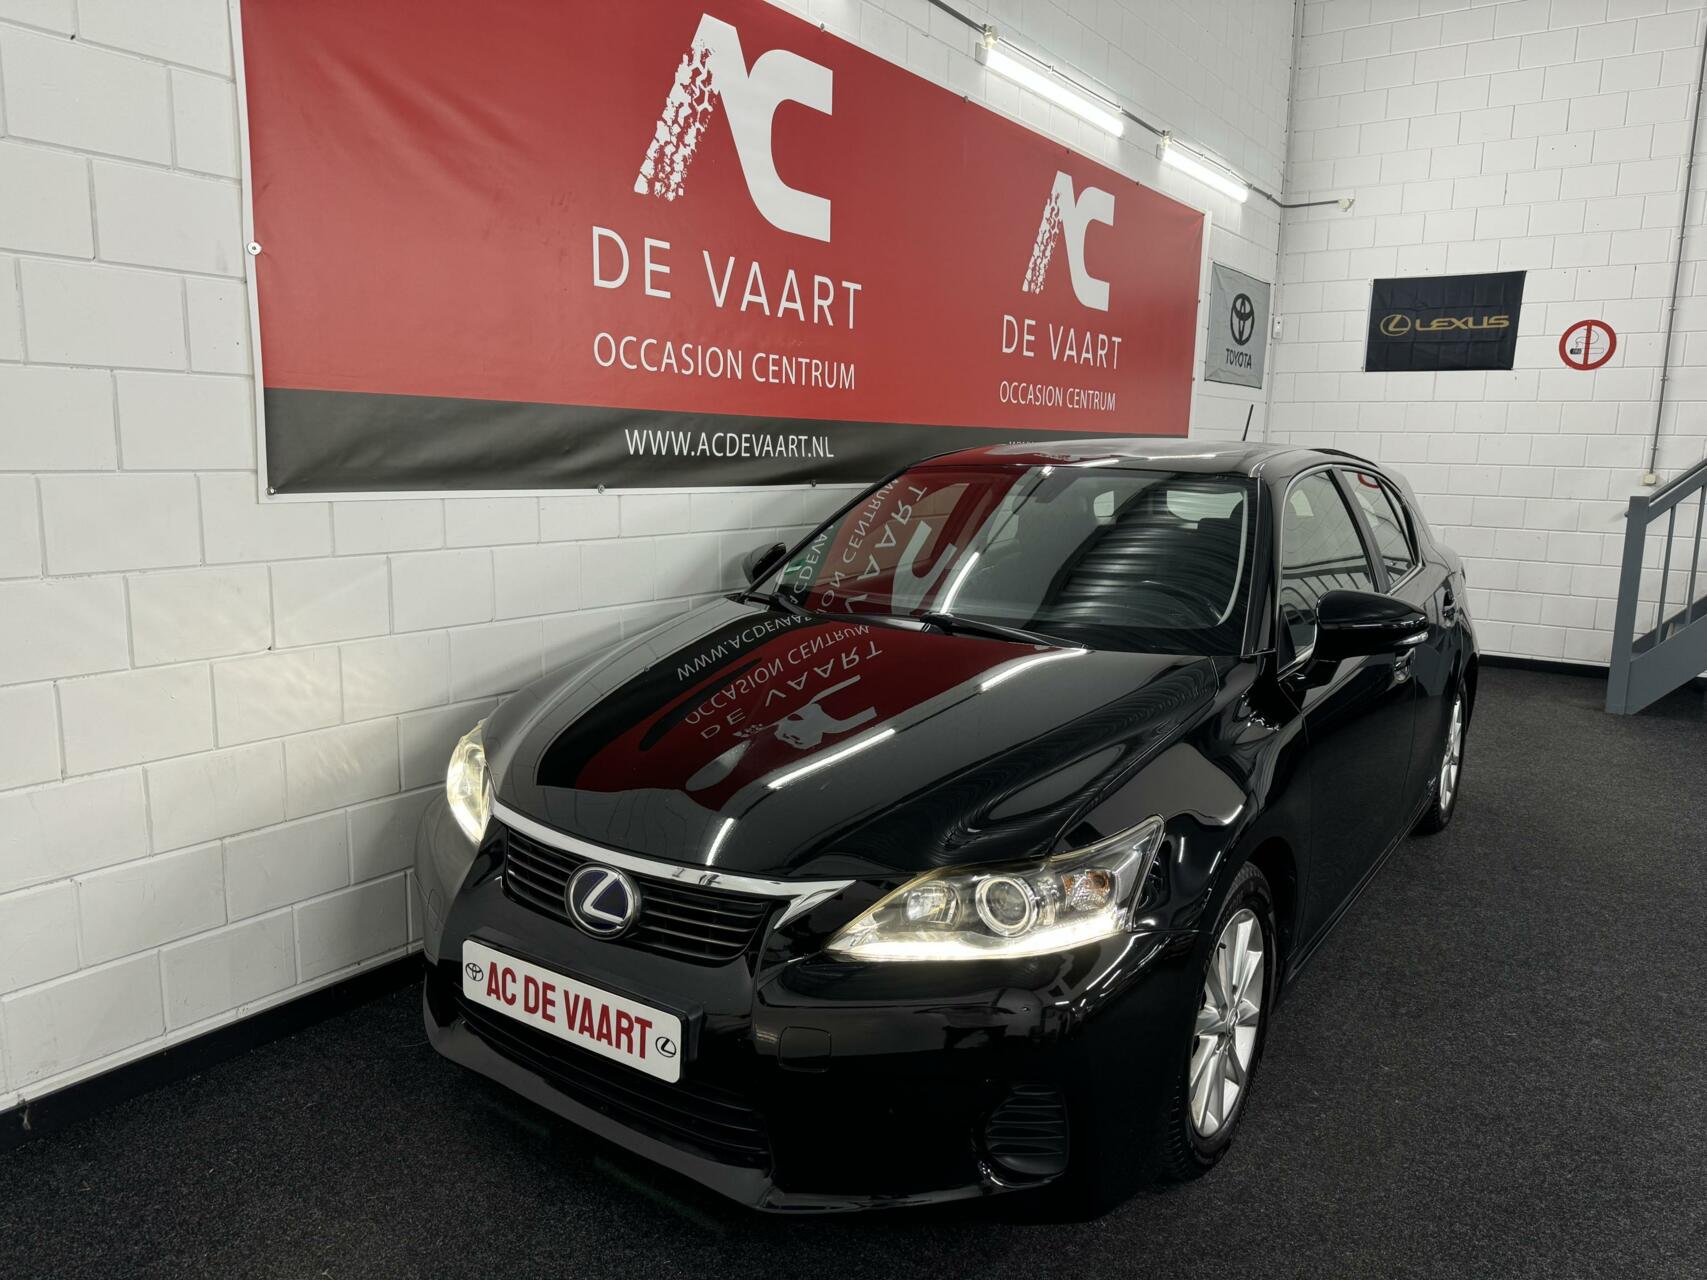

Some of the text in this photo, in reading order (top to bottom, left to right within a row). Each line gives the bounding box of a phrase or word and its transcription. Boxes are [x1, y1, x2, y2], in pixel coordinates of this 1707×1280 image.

[592, 225, 862, 329] DE VAART
[1001, 314, 1122, 370] DE VAART
[1415, 315, 1510, 331] LEXUS
[593, 332, 855, 390] OCCASION CENTRUM
[1225, 348, 1252, 369] TOYOTA
[999, 380, 1116, 411] OCCASION CENTRUM
[625, 428, 834, 458] WWW.ACDEVAART.NL
[486, 961, 516, 1005] AC
[523, 974, 556, 1024] DE
[563, 989, 653, 1059] VAART
